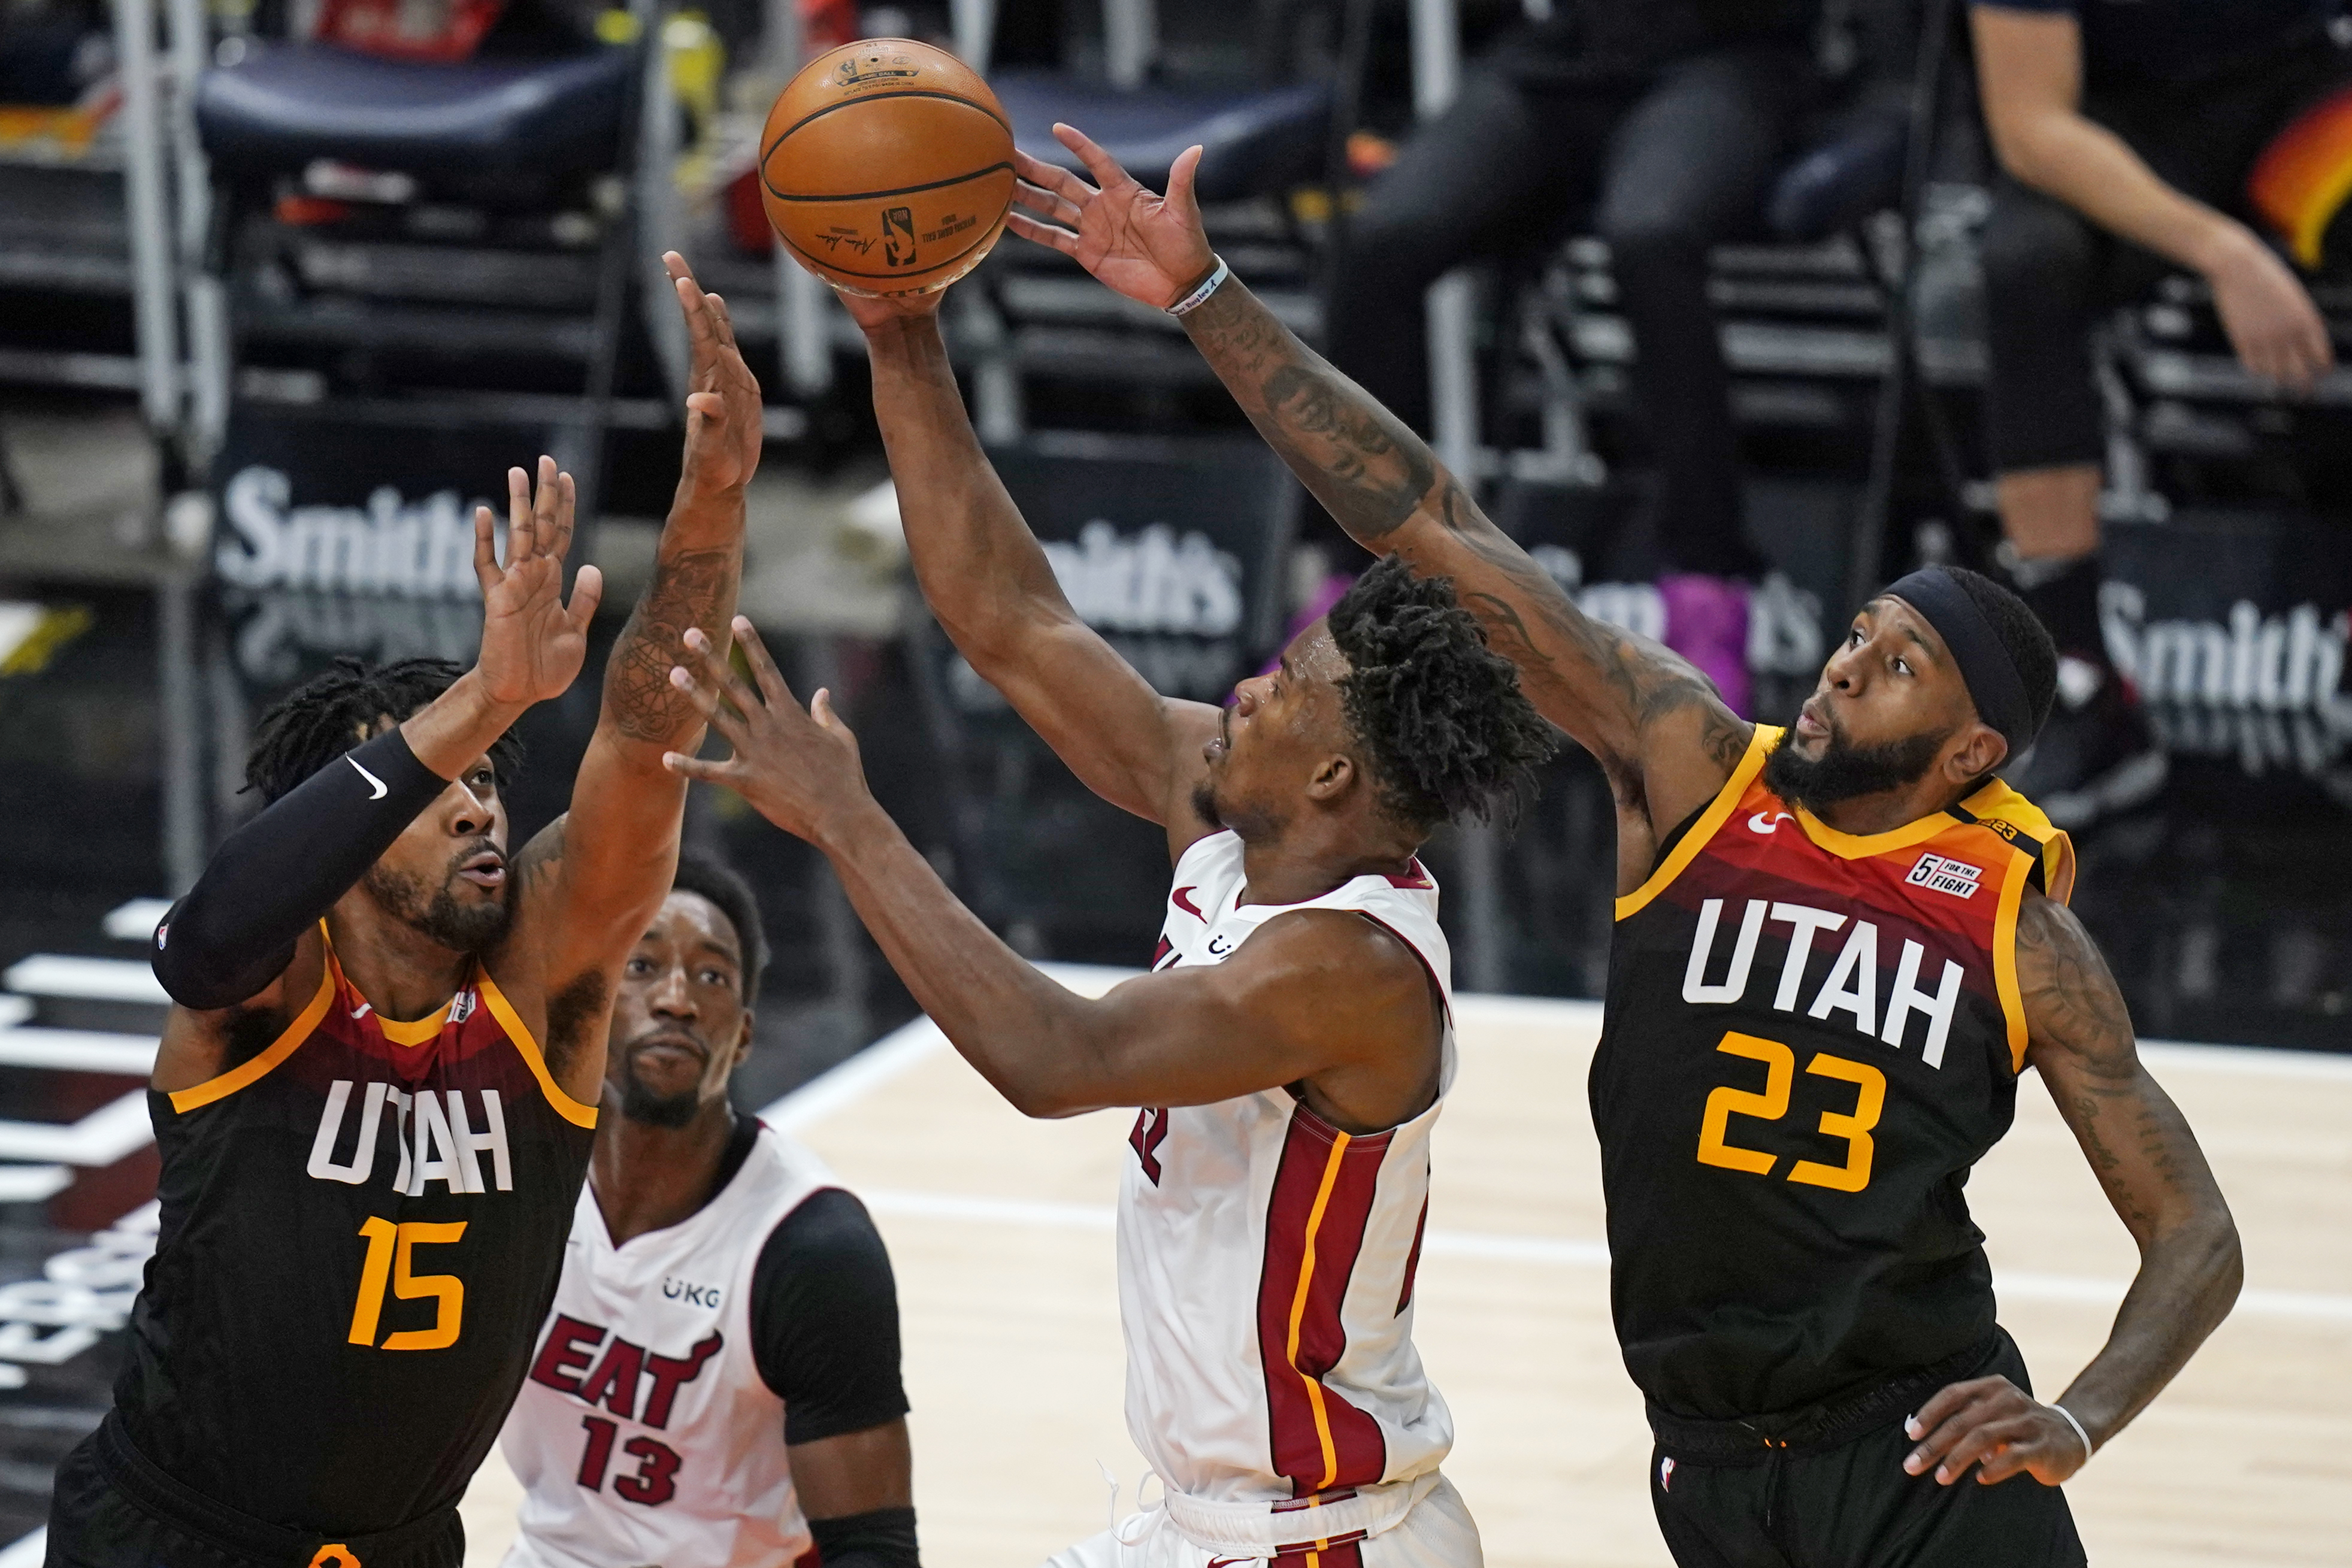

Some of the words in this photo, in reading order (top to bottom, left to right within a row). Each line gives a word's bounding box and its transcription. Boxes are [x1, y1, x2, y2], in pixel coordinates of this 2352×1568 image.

[216, 465, 511, 599] Smith
[1039, 517, 1245, 637] ith's
[2097, 579, 2350, 713] Smith
[1912, 856, 1939, 882] 5
[1931, 875, 1974, 895] FIGHT
[1944, 862, 1959, 873] FOR
[1960, 867, 1977, 877] THE
[1681, 898, 1964, 1071] UTAH
[306, 1079, 513, 1197] UTAH
[1697, 1030, 1887, 1192] 23
[347, 1215, 456, 1351] 15
[663, 1277, 721, 1308] UKG
[529, 1312, 724, 1431] EAT
[577, 1414, 682, 1507] 13
